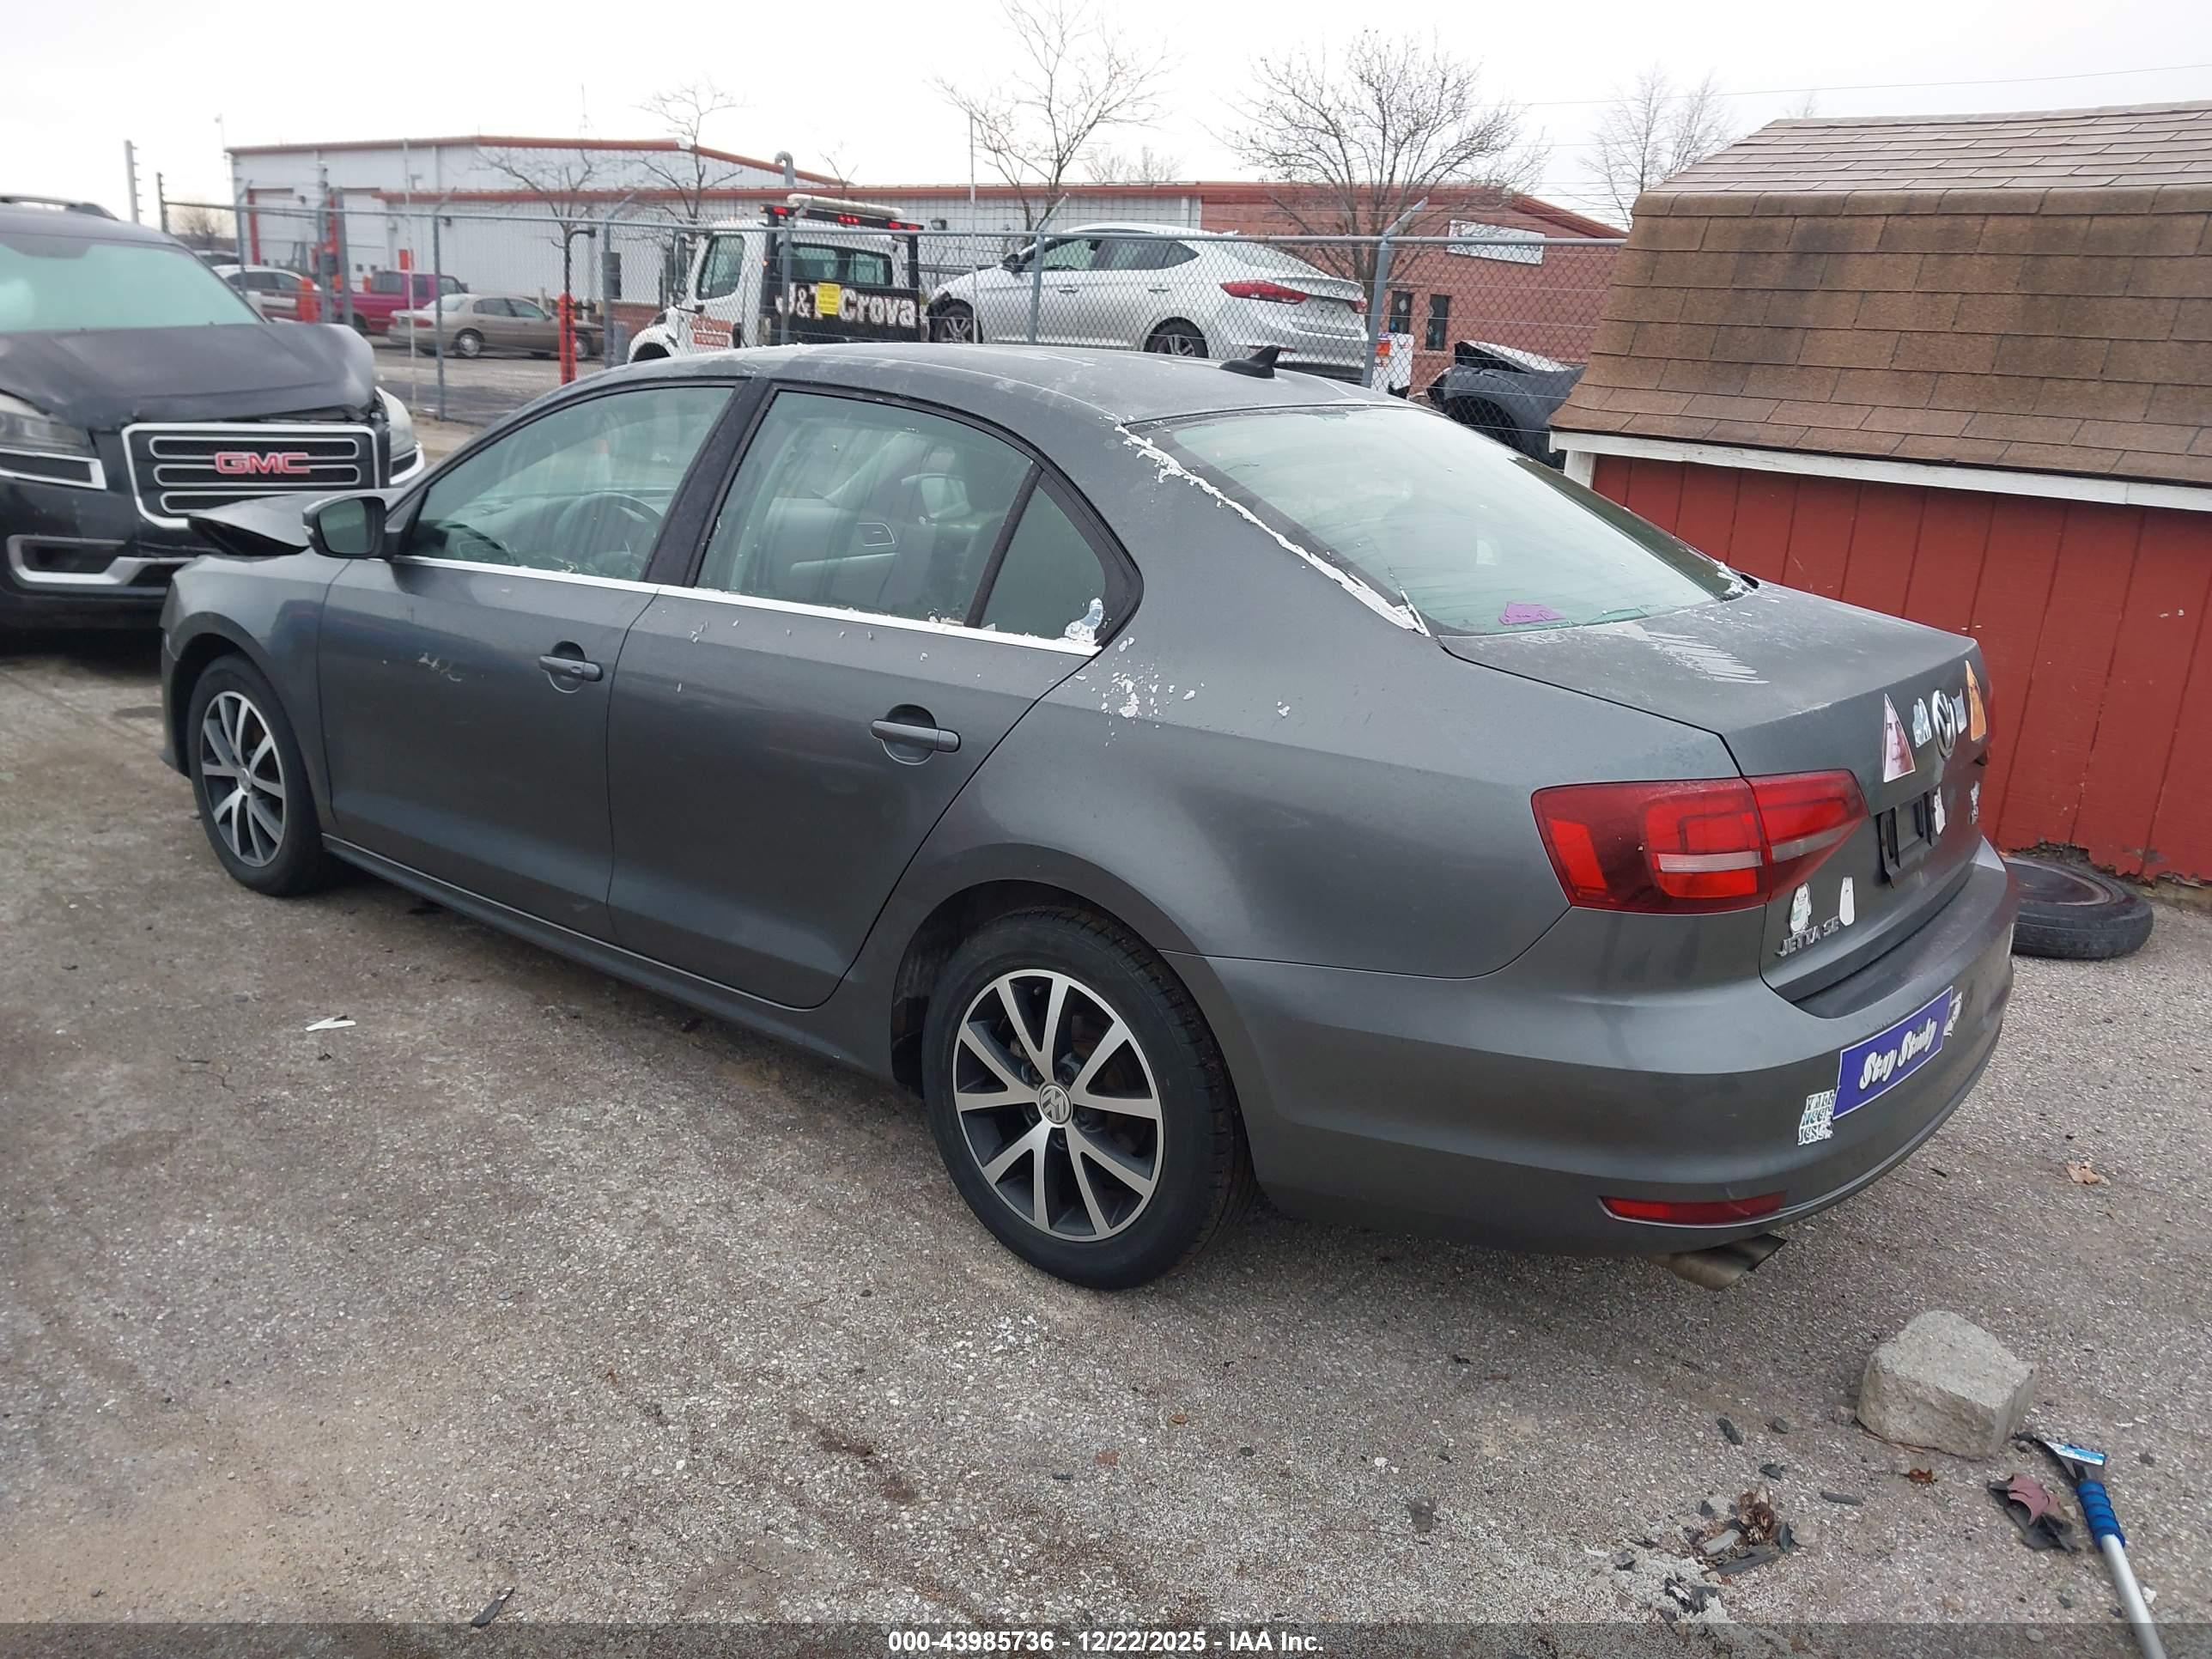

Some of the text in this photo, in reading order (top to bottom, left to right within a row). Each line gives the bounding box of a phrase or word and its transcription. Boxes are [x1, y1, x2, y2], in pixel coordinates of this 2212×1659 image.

[838, 287, 917, 329] Crova
[215, 451, 311, 474] GMC
[1776, 915, 1840, 957] JETTA SE
[1859, 1049, 1898, 1090] Stay
